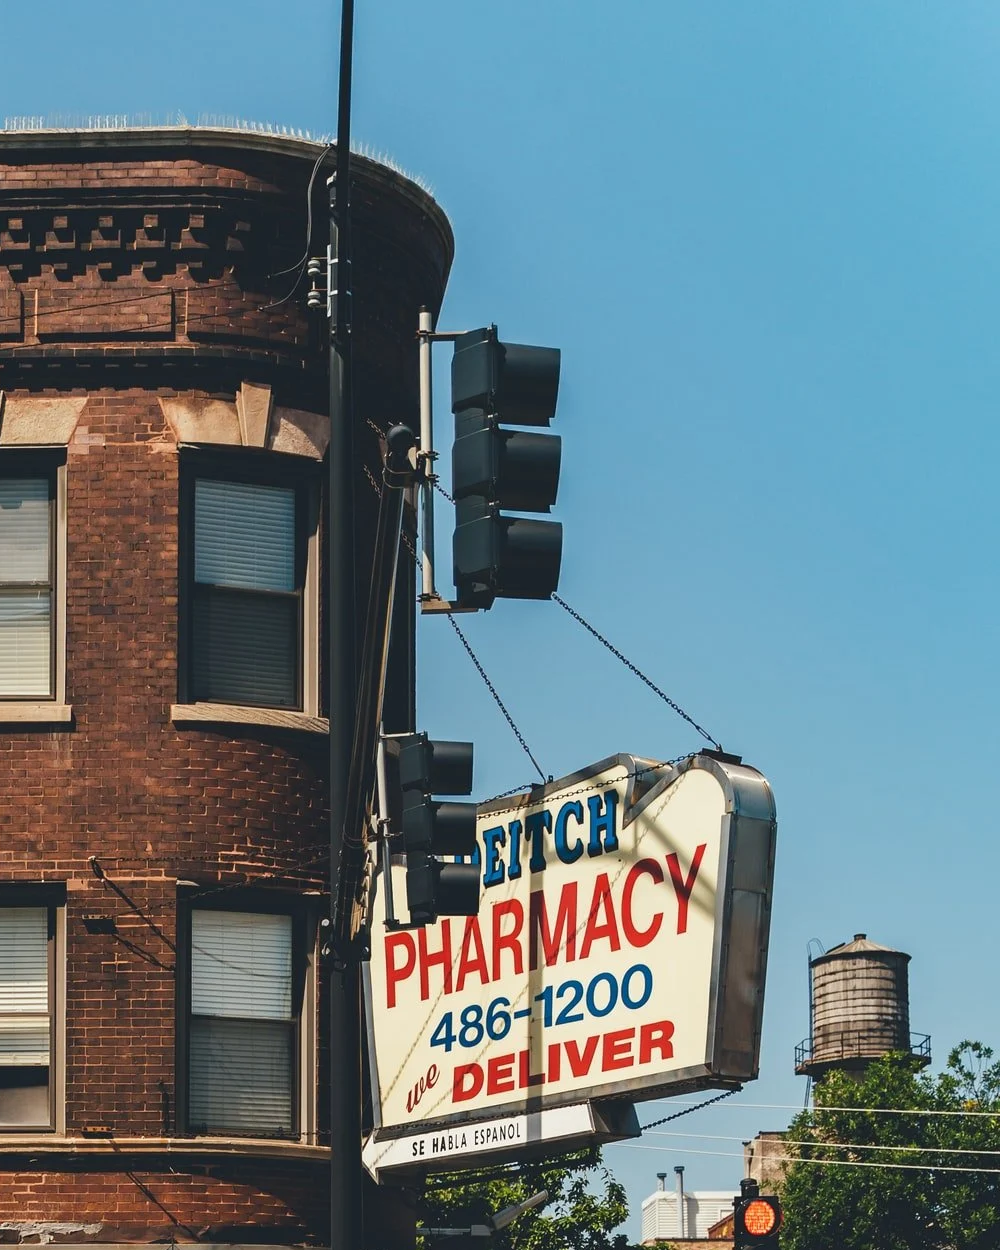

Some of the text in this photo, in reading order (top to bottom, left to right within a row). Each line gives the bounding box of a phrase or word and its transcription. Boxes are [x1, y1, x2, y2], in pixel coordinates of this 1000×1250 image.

[455, 788, 620, 890] EITCH
[384, 843, 707, 1009] PHARMACY
[430, 963, 653, 1053] 486-1200
[405, 1020, 676, 1114] we DELIVER
[412, 1122, 521, 1157] SE HABLA ESPANOL
